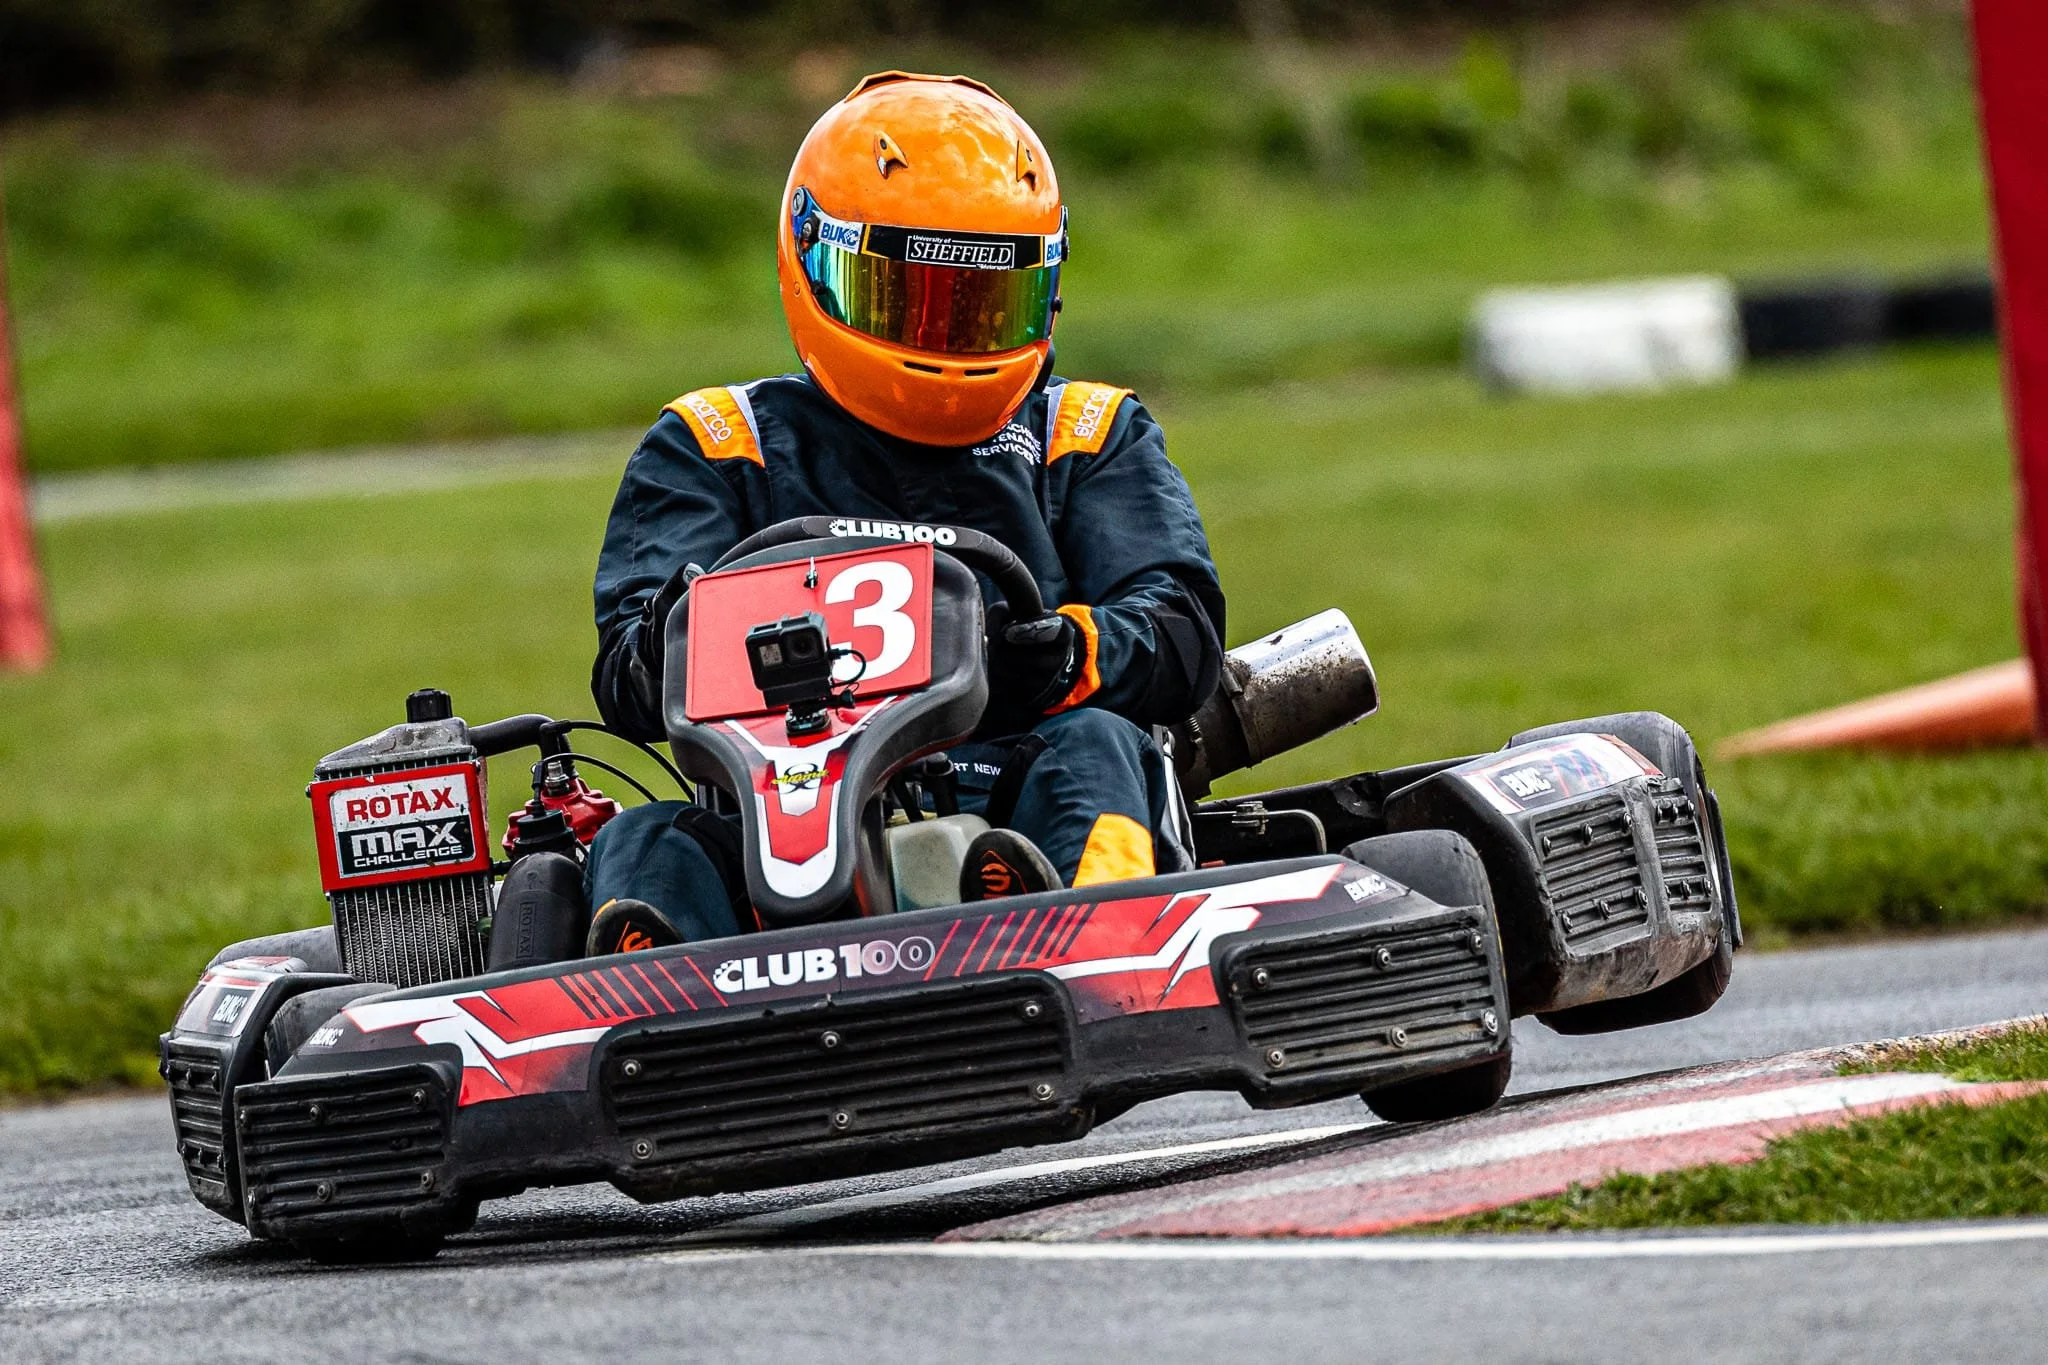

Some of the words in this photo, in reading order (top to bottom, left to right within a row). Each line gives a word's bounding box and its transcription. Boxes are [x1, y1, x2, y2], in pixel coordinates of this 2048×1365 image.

[821, 222, 859, 247] BUKC
[912, 234, 943, 243] University
[910, 241, 1012, 264] SHEFFIELD
[829, 519, 957, 546] CLUB100
[825, 560, 916, 682] 3
[346, 787, 456, 823] ROTAX
[713, 936, 936, 993] CLUB100
